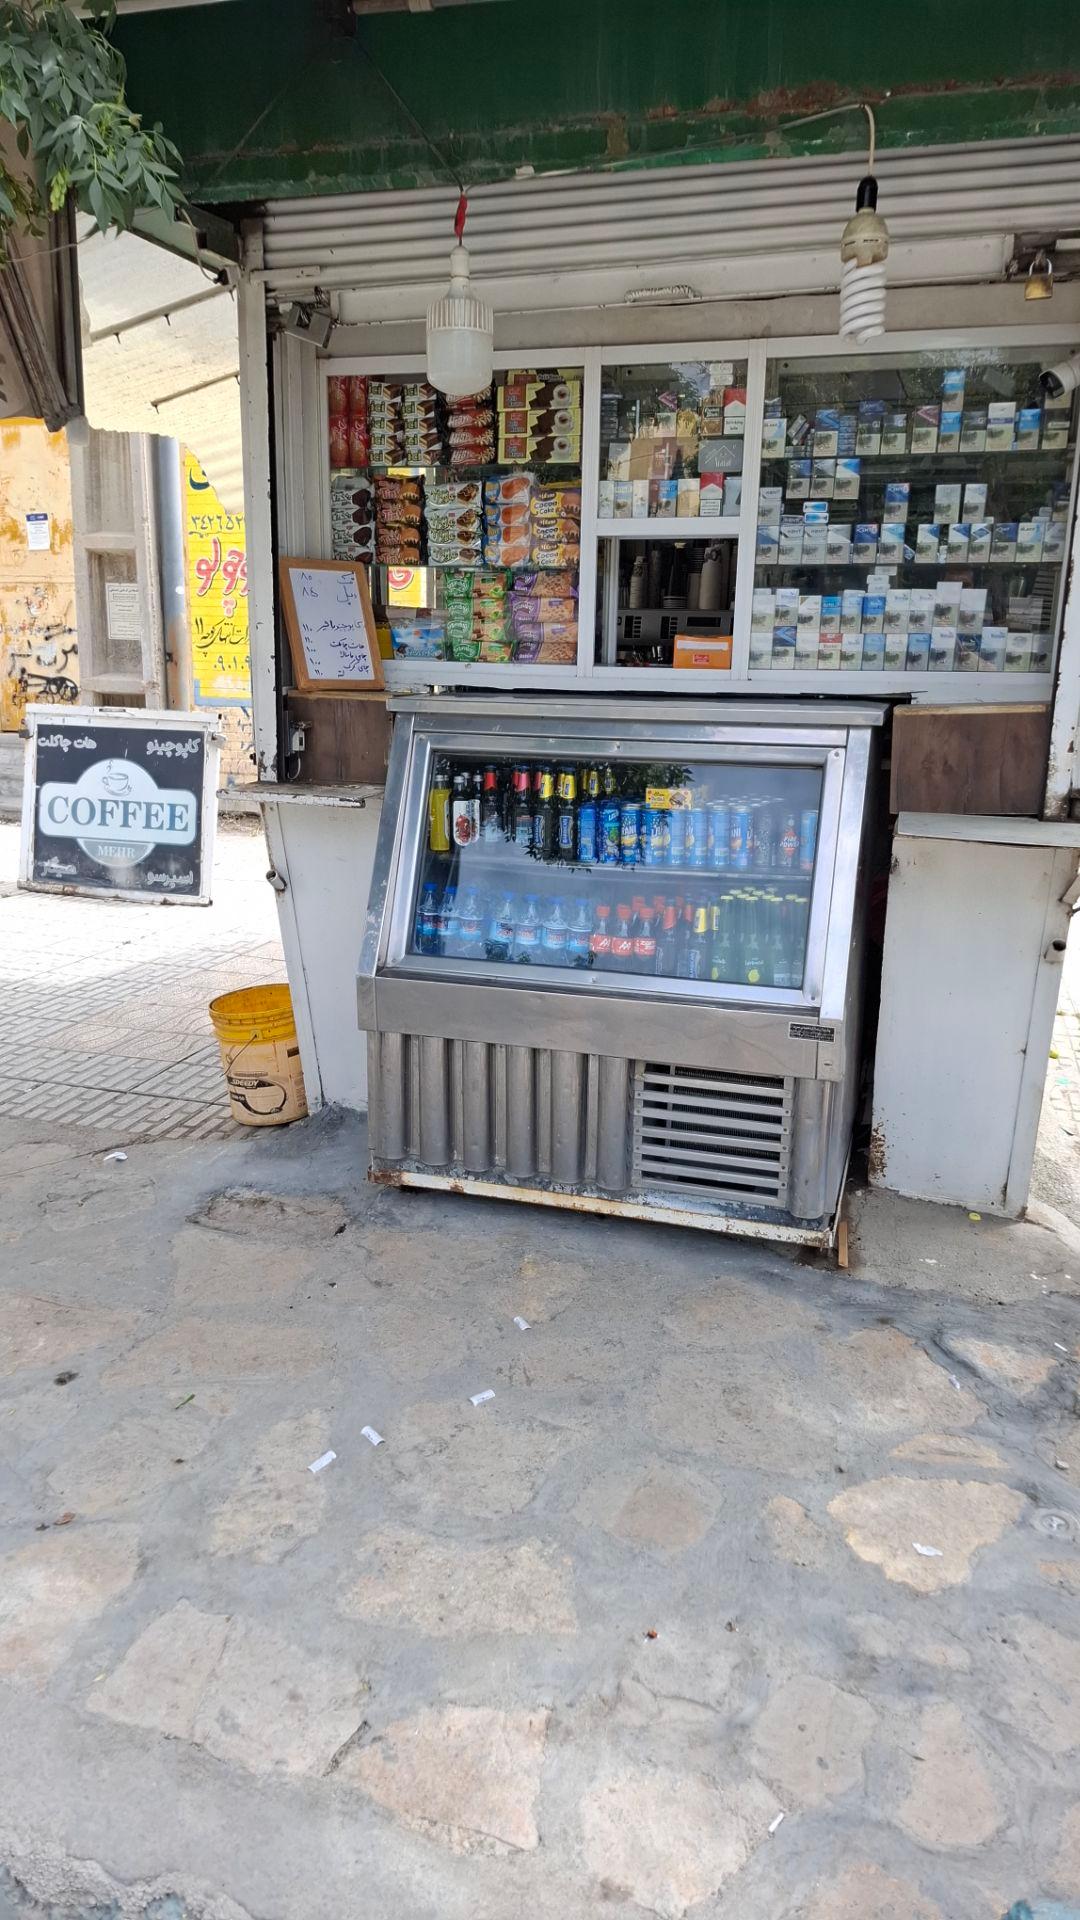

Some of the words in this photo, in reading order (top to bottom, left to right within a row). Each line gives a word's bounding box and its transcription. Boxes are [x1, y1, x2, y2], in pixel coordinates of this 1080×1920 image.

[37, 734, 72, 752] چاکلت
[73, 736, 97, 749] هات
[147, 738, 201, 758] کاپوچینو
[48, 795, 189, 832] COFFEE
[97, 845, 136, 858] MEHR
